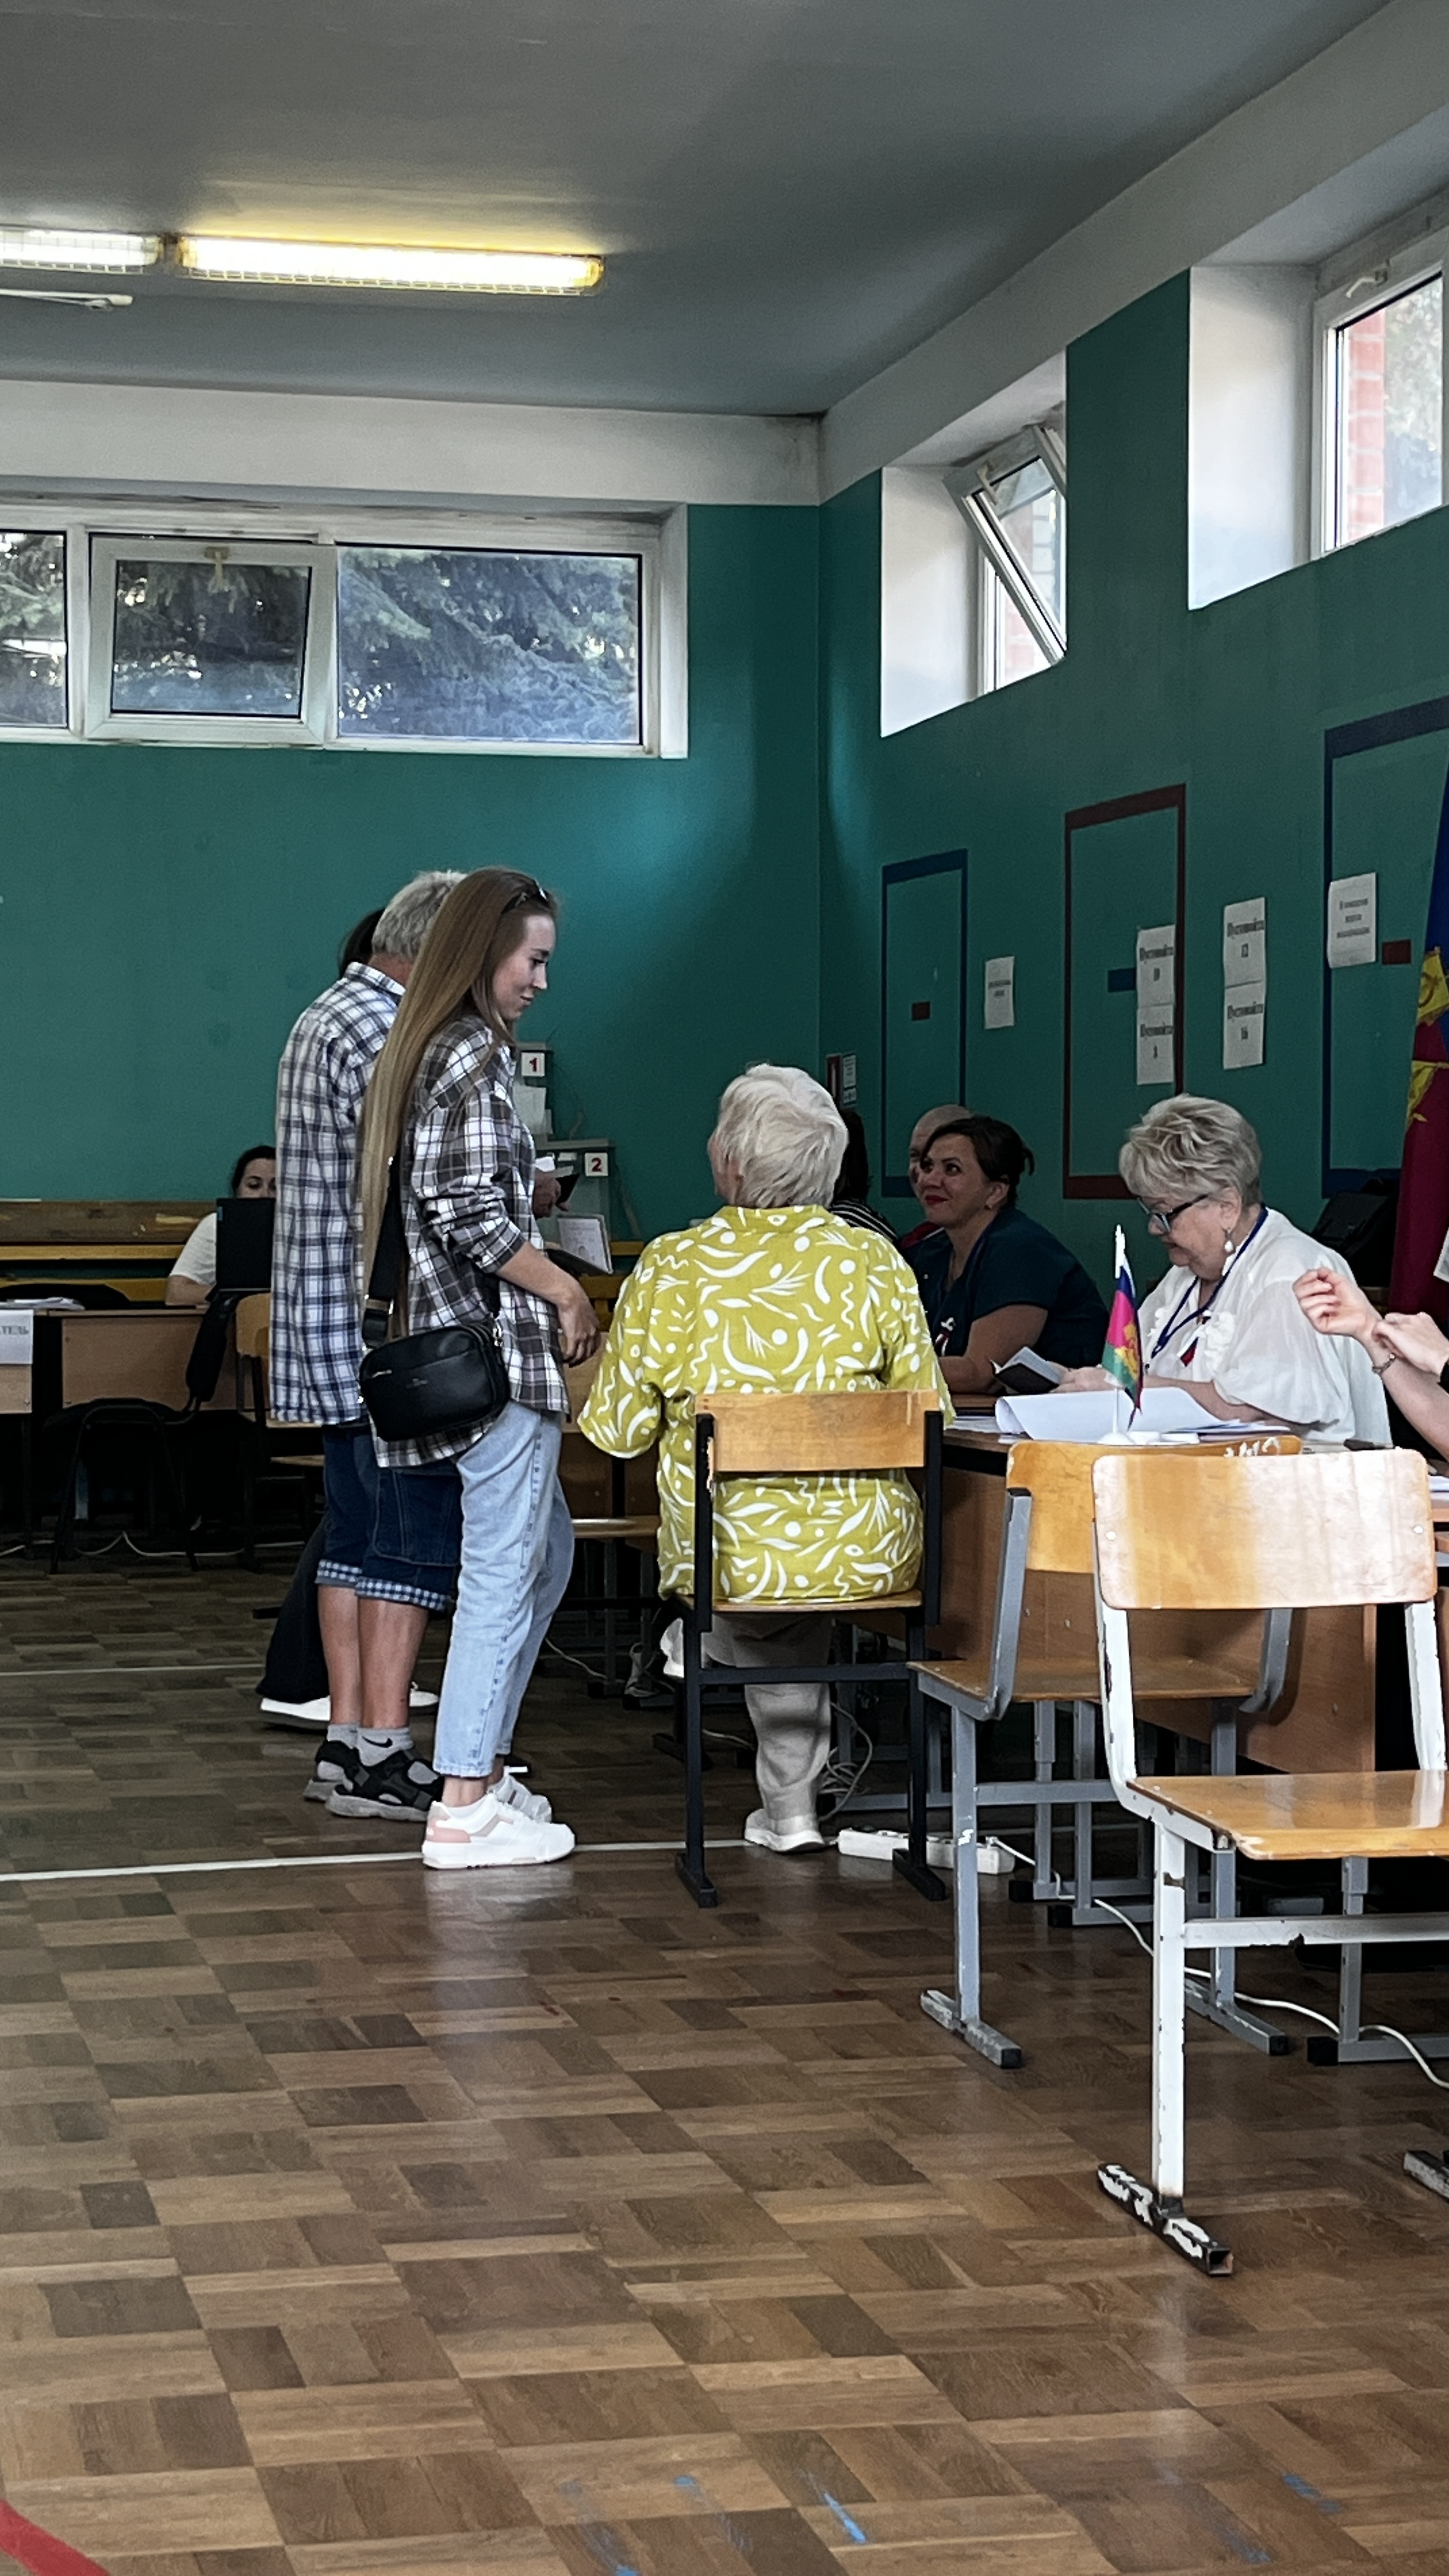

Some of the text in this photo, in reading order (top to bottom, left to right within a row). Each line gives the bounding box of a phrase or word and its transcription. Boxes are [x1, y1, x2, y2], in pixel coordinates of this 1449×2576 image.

[529, 1057, 537, 1072] 1
[591, 1157, 602, 1172] 2
[0, 1325, 29, 1335] ТЕЛЬ
